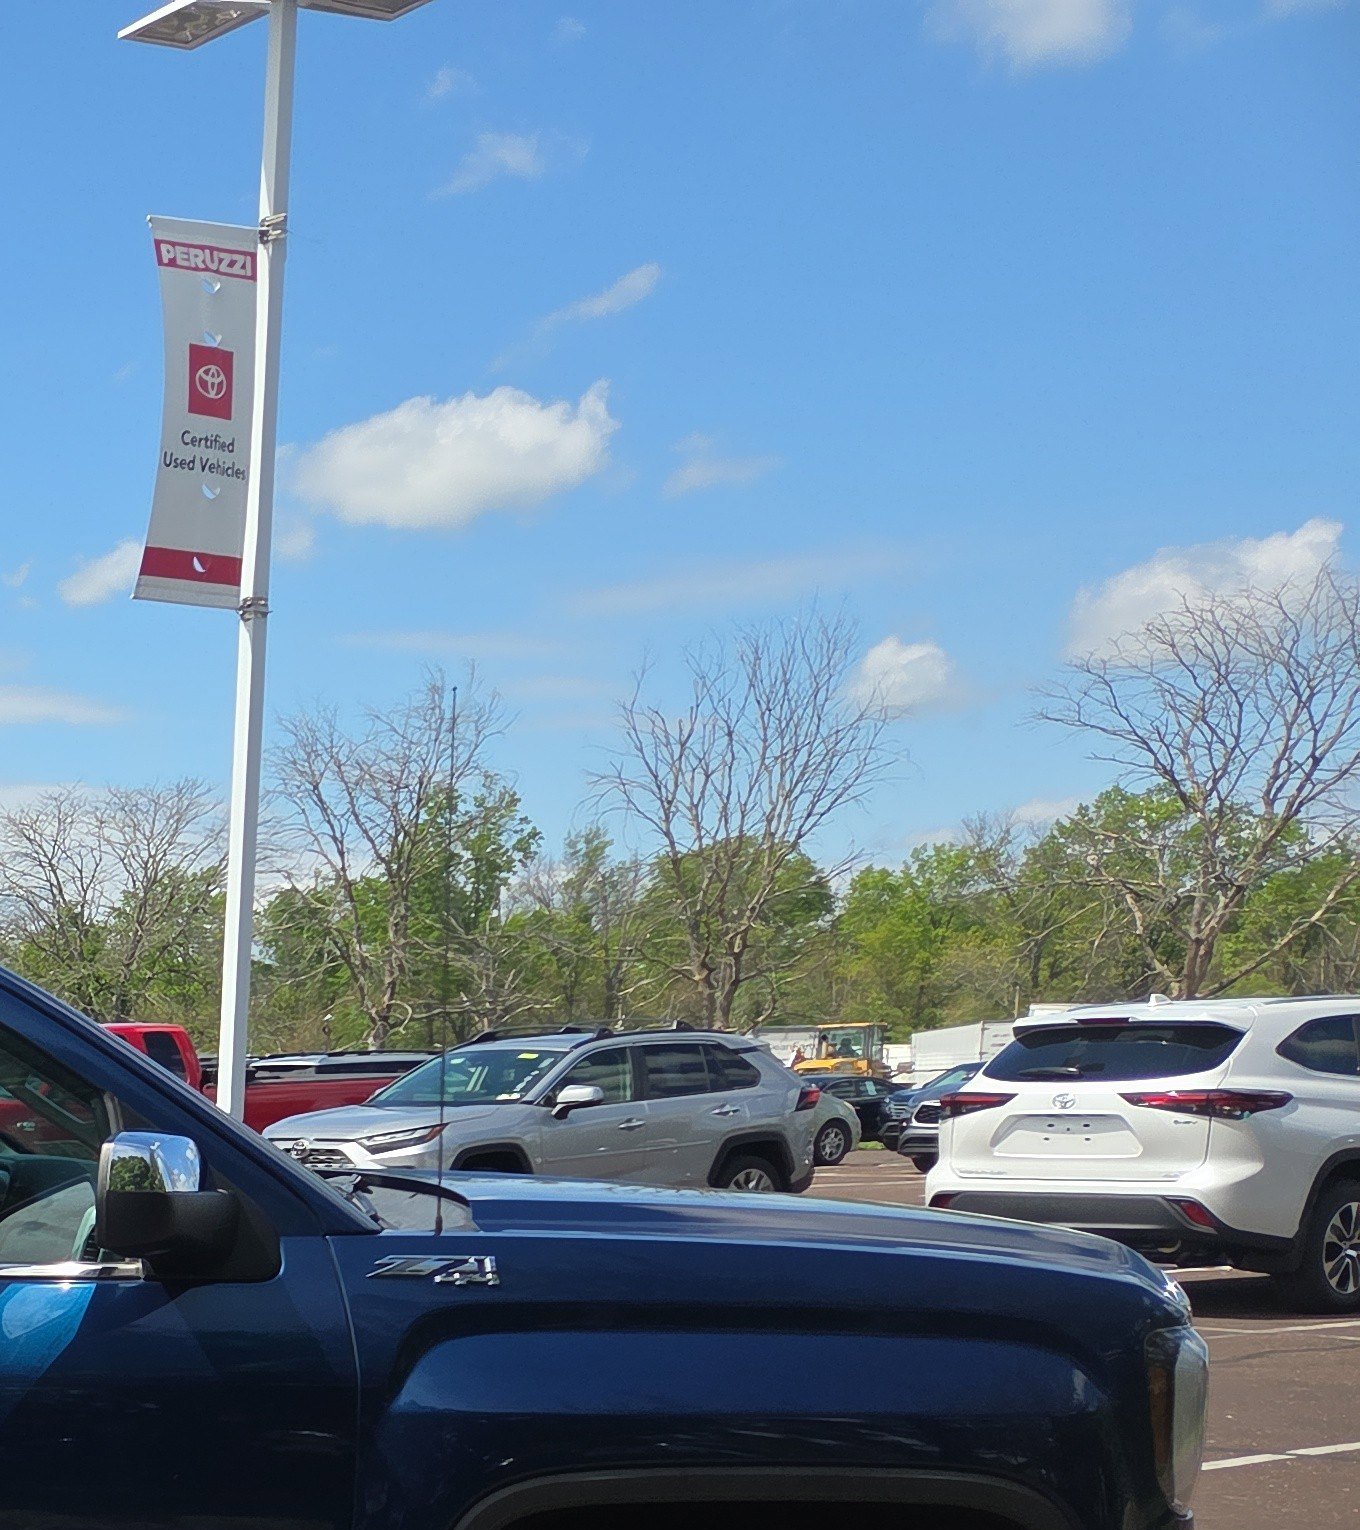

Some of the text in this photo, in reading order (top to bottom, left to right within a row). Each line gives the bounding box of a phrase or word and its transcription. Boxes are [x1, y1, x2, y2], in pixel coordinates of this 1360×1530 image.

[160, 243, 252, 277] PERUZZI
[181, 430, 236, 454] Certified
[162, 450, 247, 481] Used Vehicles
